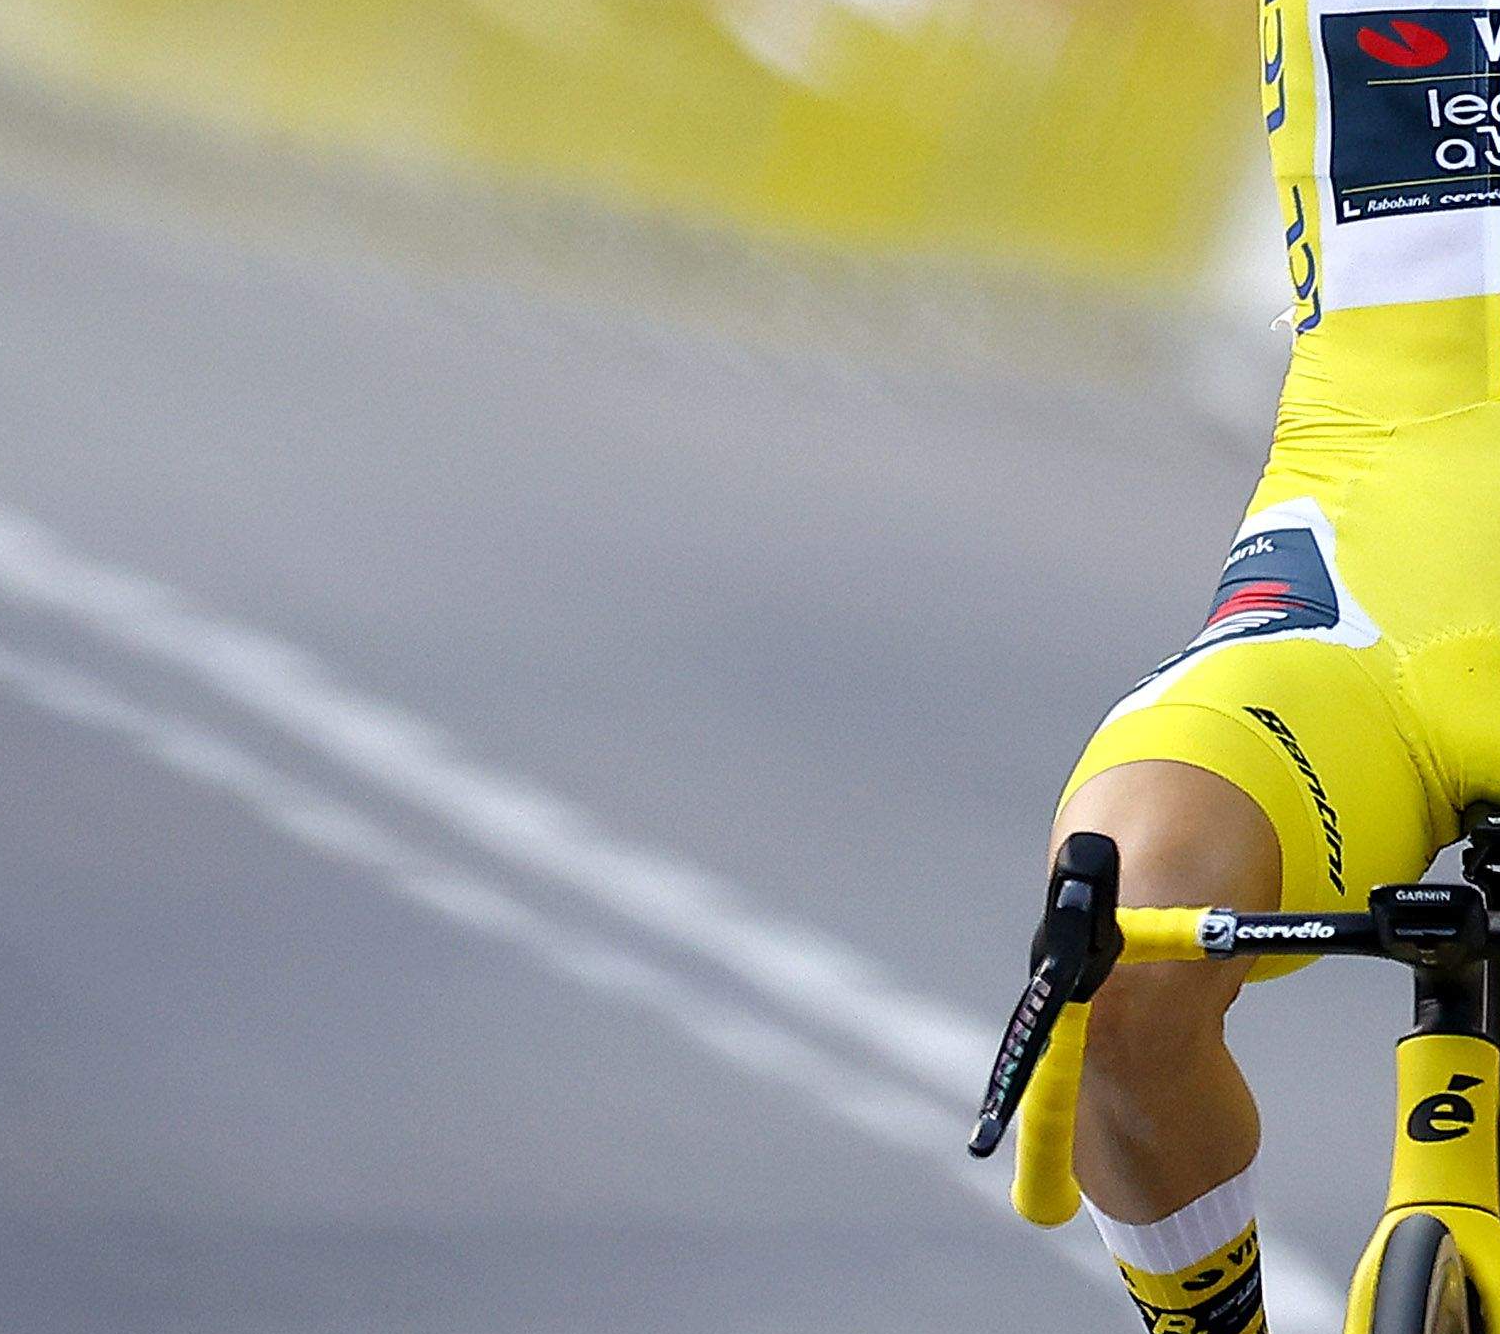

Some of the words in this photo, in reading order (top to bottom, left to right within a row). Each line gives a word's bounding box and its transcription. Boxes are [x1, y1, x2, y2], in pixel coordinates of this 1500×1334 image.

[1367, 193, 1431, 213] Rabobank
[1286, 185, 1321, 336] LCL
[1242, 706, 1345, 896] Santini
[1395, 889, 1451, 902] GARMIN
